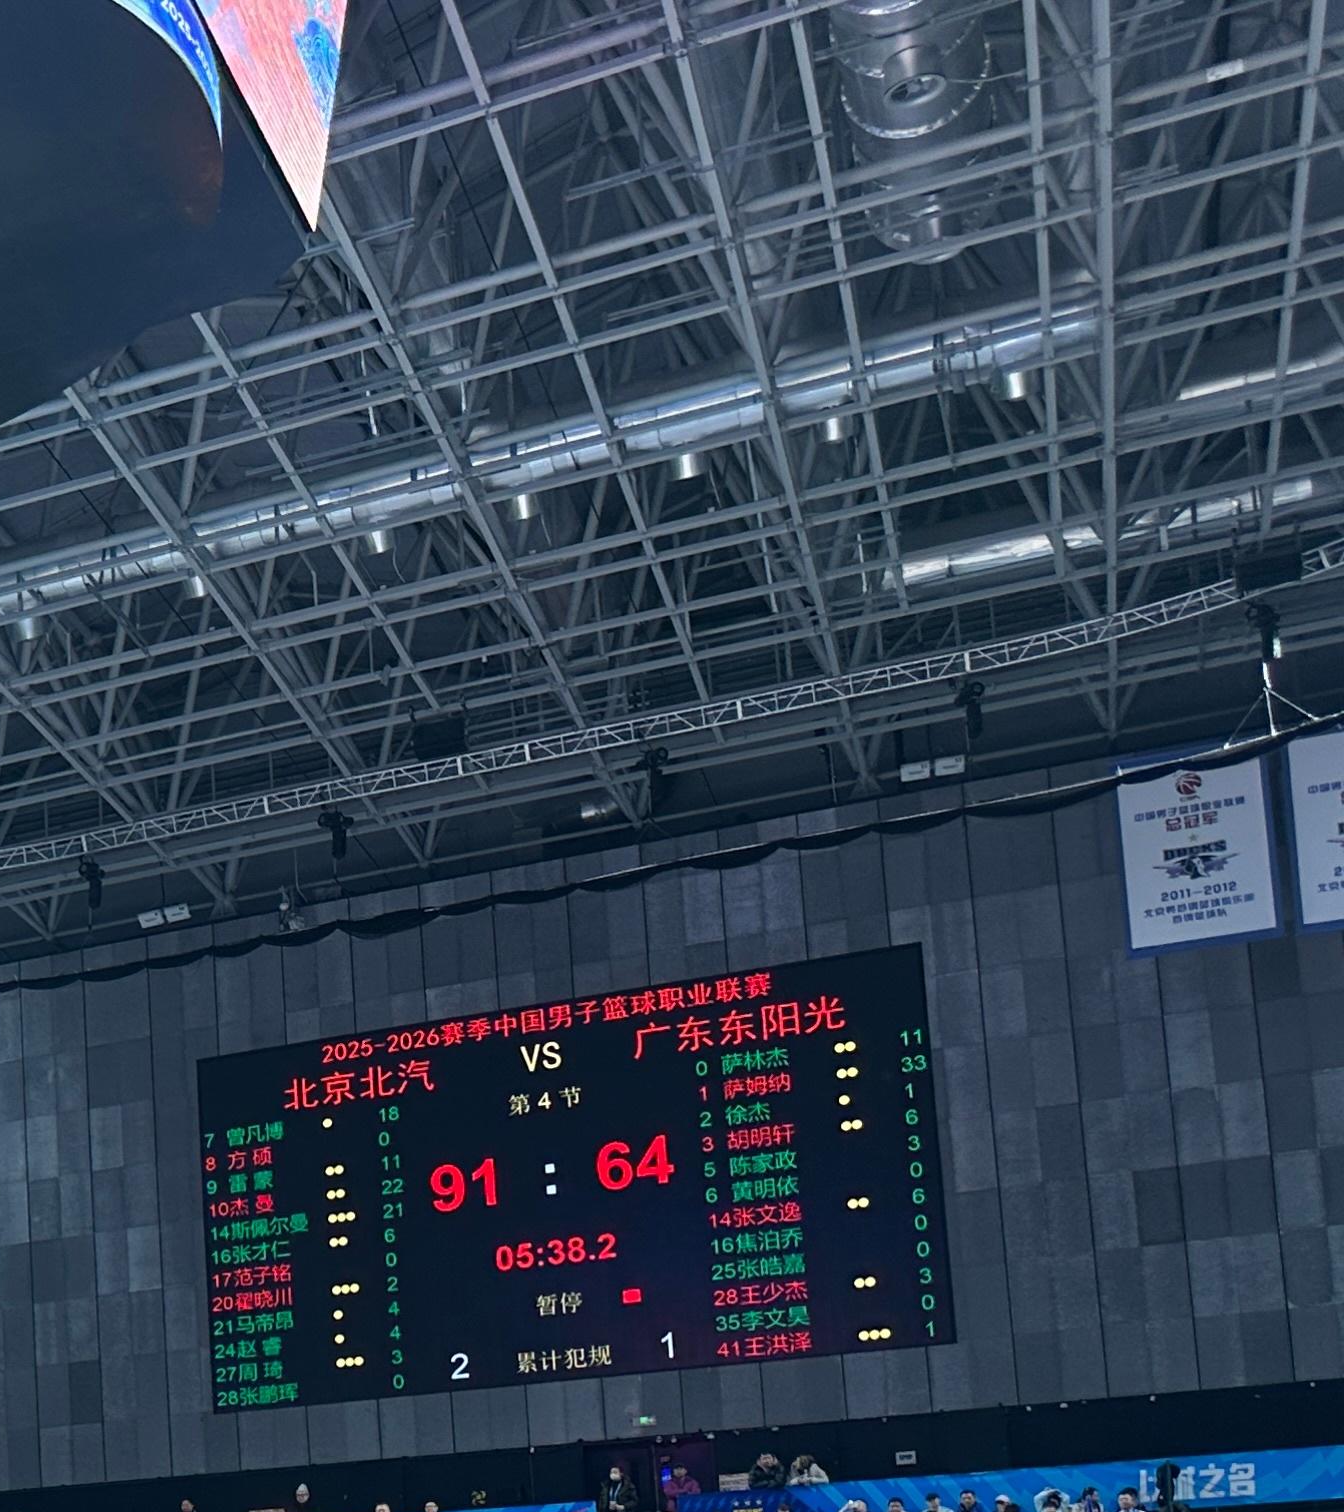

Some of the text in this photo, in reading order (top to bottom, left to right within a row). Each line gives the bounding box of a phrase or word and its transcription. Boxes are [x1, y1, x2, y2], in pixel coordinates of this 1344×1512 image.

[1165, 811, 1219, 832] 总冠军
[1163, 839, 1227, 862] DUCKS
[321, 972, 772, 1064] 2025-2026赛季中国男子篮球职业联赛
[633, 996, 846, 1060] 广东东阳光
[520, 1042, 562, 1072] VS
[696, 1029, 922, 1076] 0 萨林杰 11
[284, 1060, 434, 1111] 北京北汽
[699, 1056, 926, 1100] 1 萨姆纳 33
[700, 1084, 913, 1127] 2 徐杰 1
[204, 1107, 399, 1148] 7 曾凡博 18
[703, 1110, 918, 1152] 3 胡明轩 6
[205, 1157, 216, 1171] 8
[379, 1132, 390, 1145] 0
[704, 1136, 920, 1177] 5 陈家政 3
[207, 1180, 217, 1195] 9
[382, 1155, 400, 1170] 11
[429, 1158, 498, 1213] 91
[596, 1134, 675, 1191] 64
[706, 1163, 922, 1203] 6 黄明依 0
[382, 1179, 404, 1194] 22
[913, 1189, 924, 1203] 6
[383, 1203, 403, 1219] 21
[915, 1215, 927, 1229] 0
[384, 1229, 395, 1242] 6
[385, 1253, 397, 1267] 0
[496, 1233, 617, 1271] 05:38.2
[917, 1242, 929, 1256] 0
[387, 1277, 398, 1291] 2
[920, 1269, 932, 1283] 3
[388, 1302, 399, 1316] 4
[536, 1292, 582, 1317] 暂停
[922, 1295, 934, 1310] 0
[390, 1326, 400, 1339] 4
[925, 1322, 935, 1337] 1
[392, 1350, 403, 1364] 3
[450, 1331, 674, 1380] 2 累计犯规 1
[393, 1375, 404, 1389] 0
